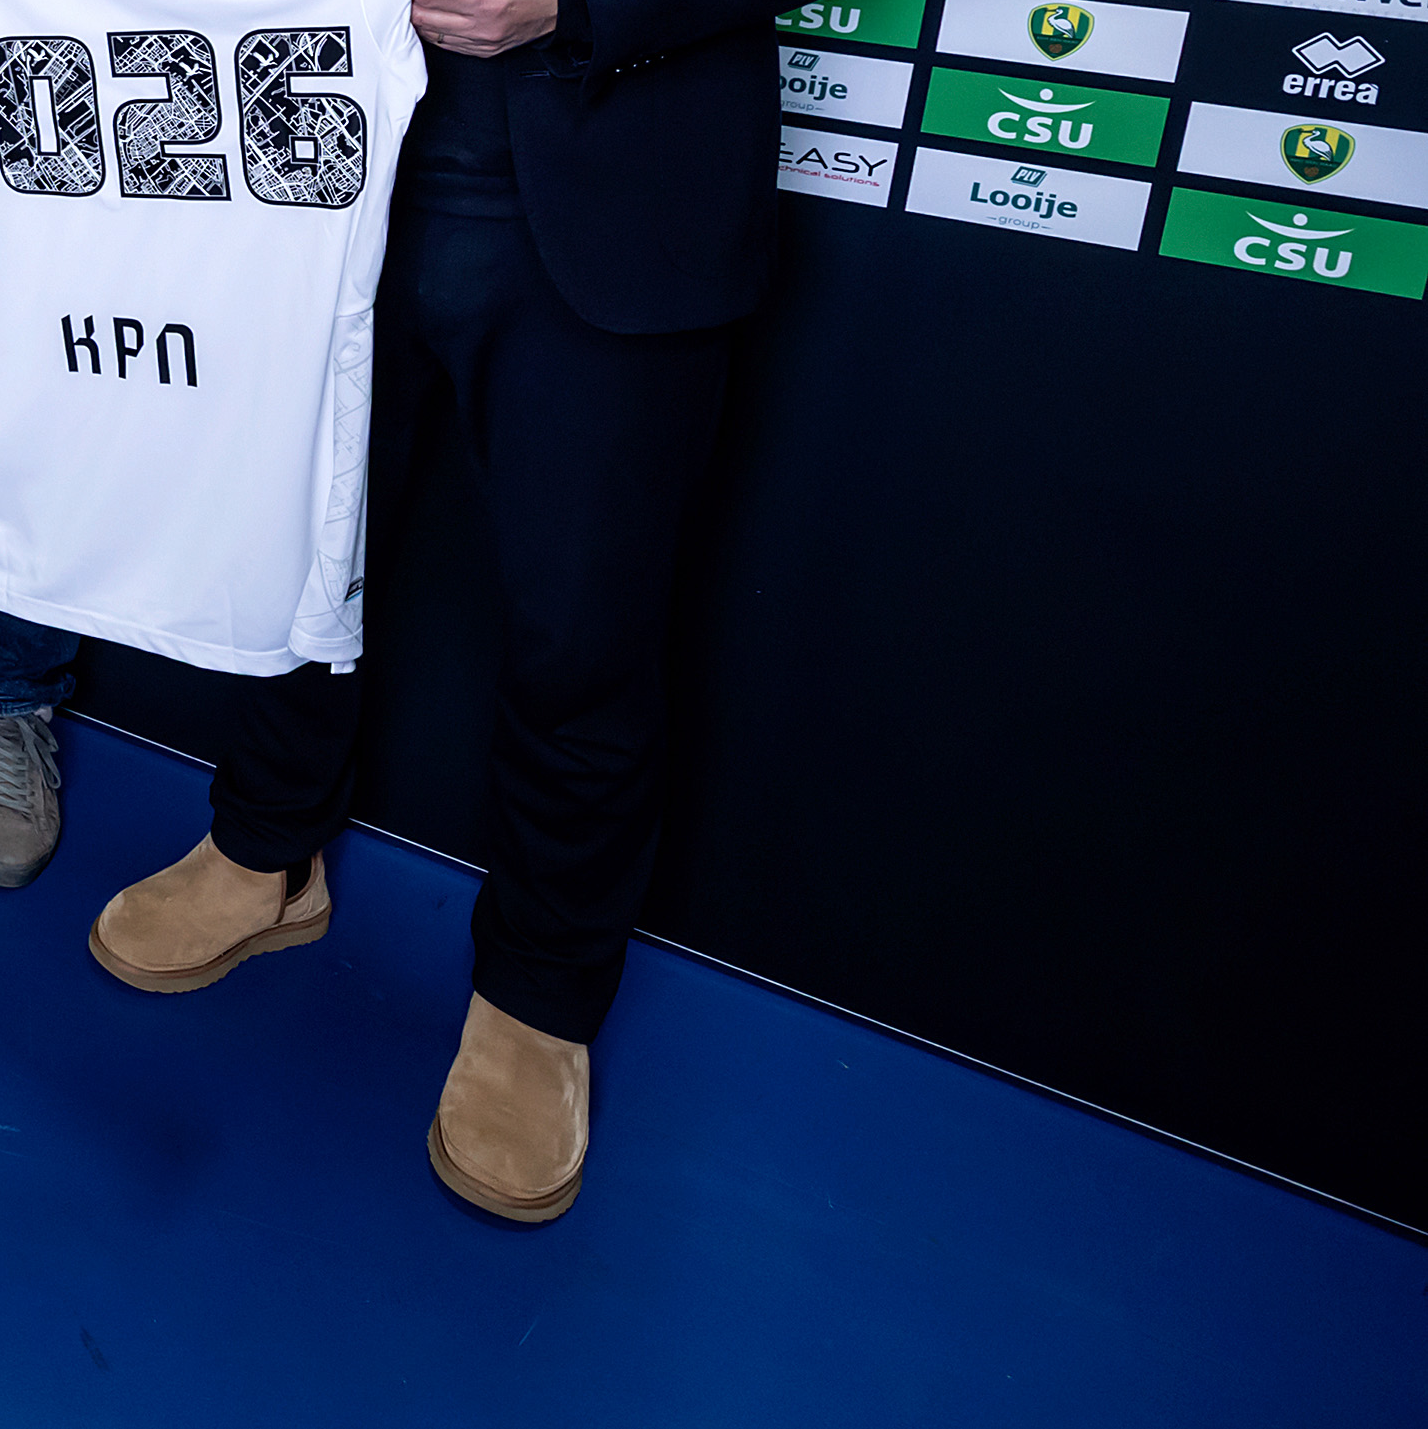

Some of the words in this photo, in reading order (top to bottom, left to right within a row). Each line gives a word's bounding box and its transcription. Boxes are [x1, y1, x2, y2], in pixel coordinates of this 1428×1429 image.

[986, 112, 1094, 150] CSU
[824, 172, 881, 188] solutions
[969, 182, 1079, 220] Looije
[998, 215, 1041, 231] group
[1233, 235, 1353, 279] CSU
[60, 312, 199, 389] KPN
